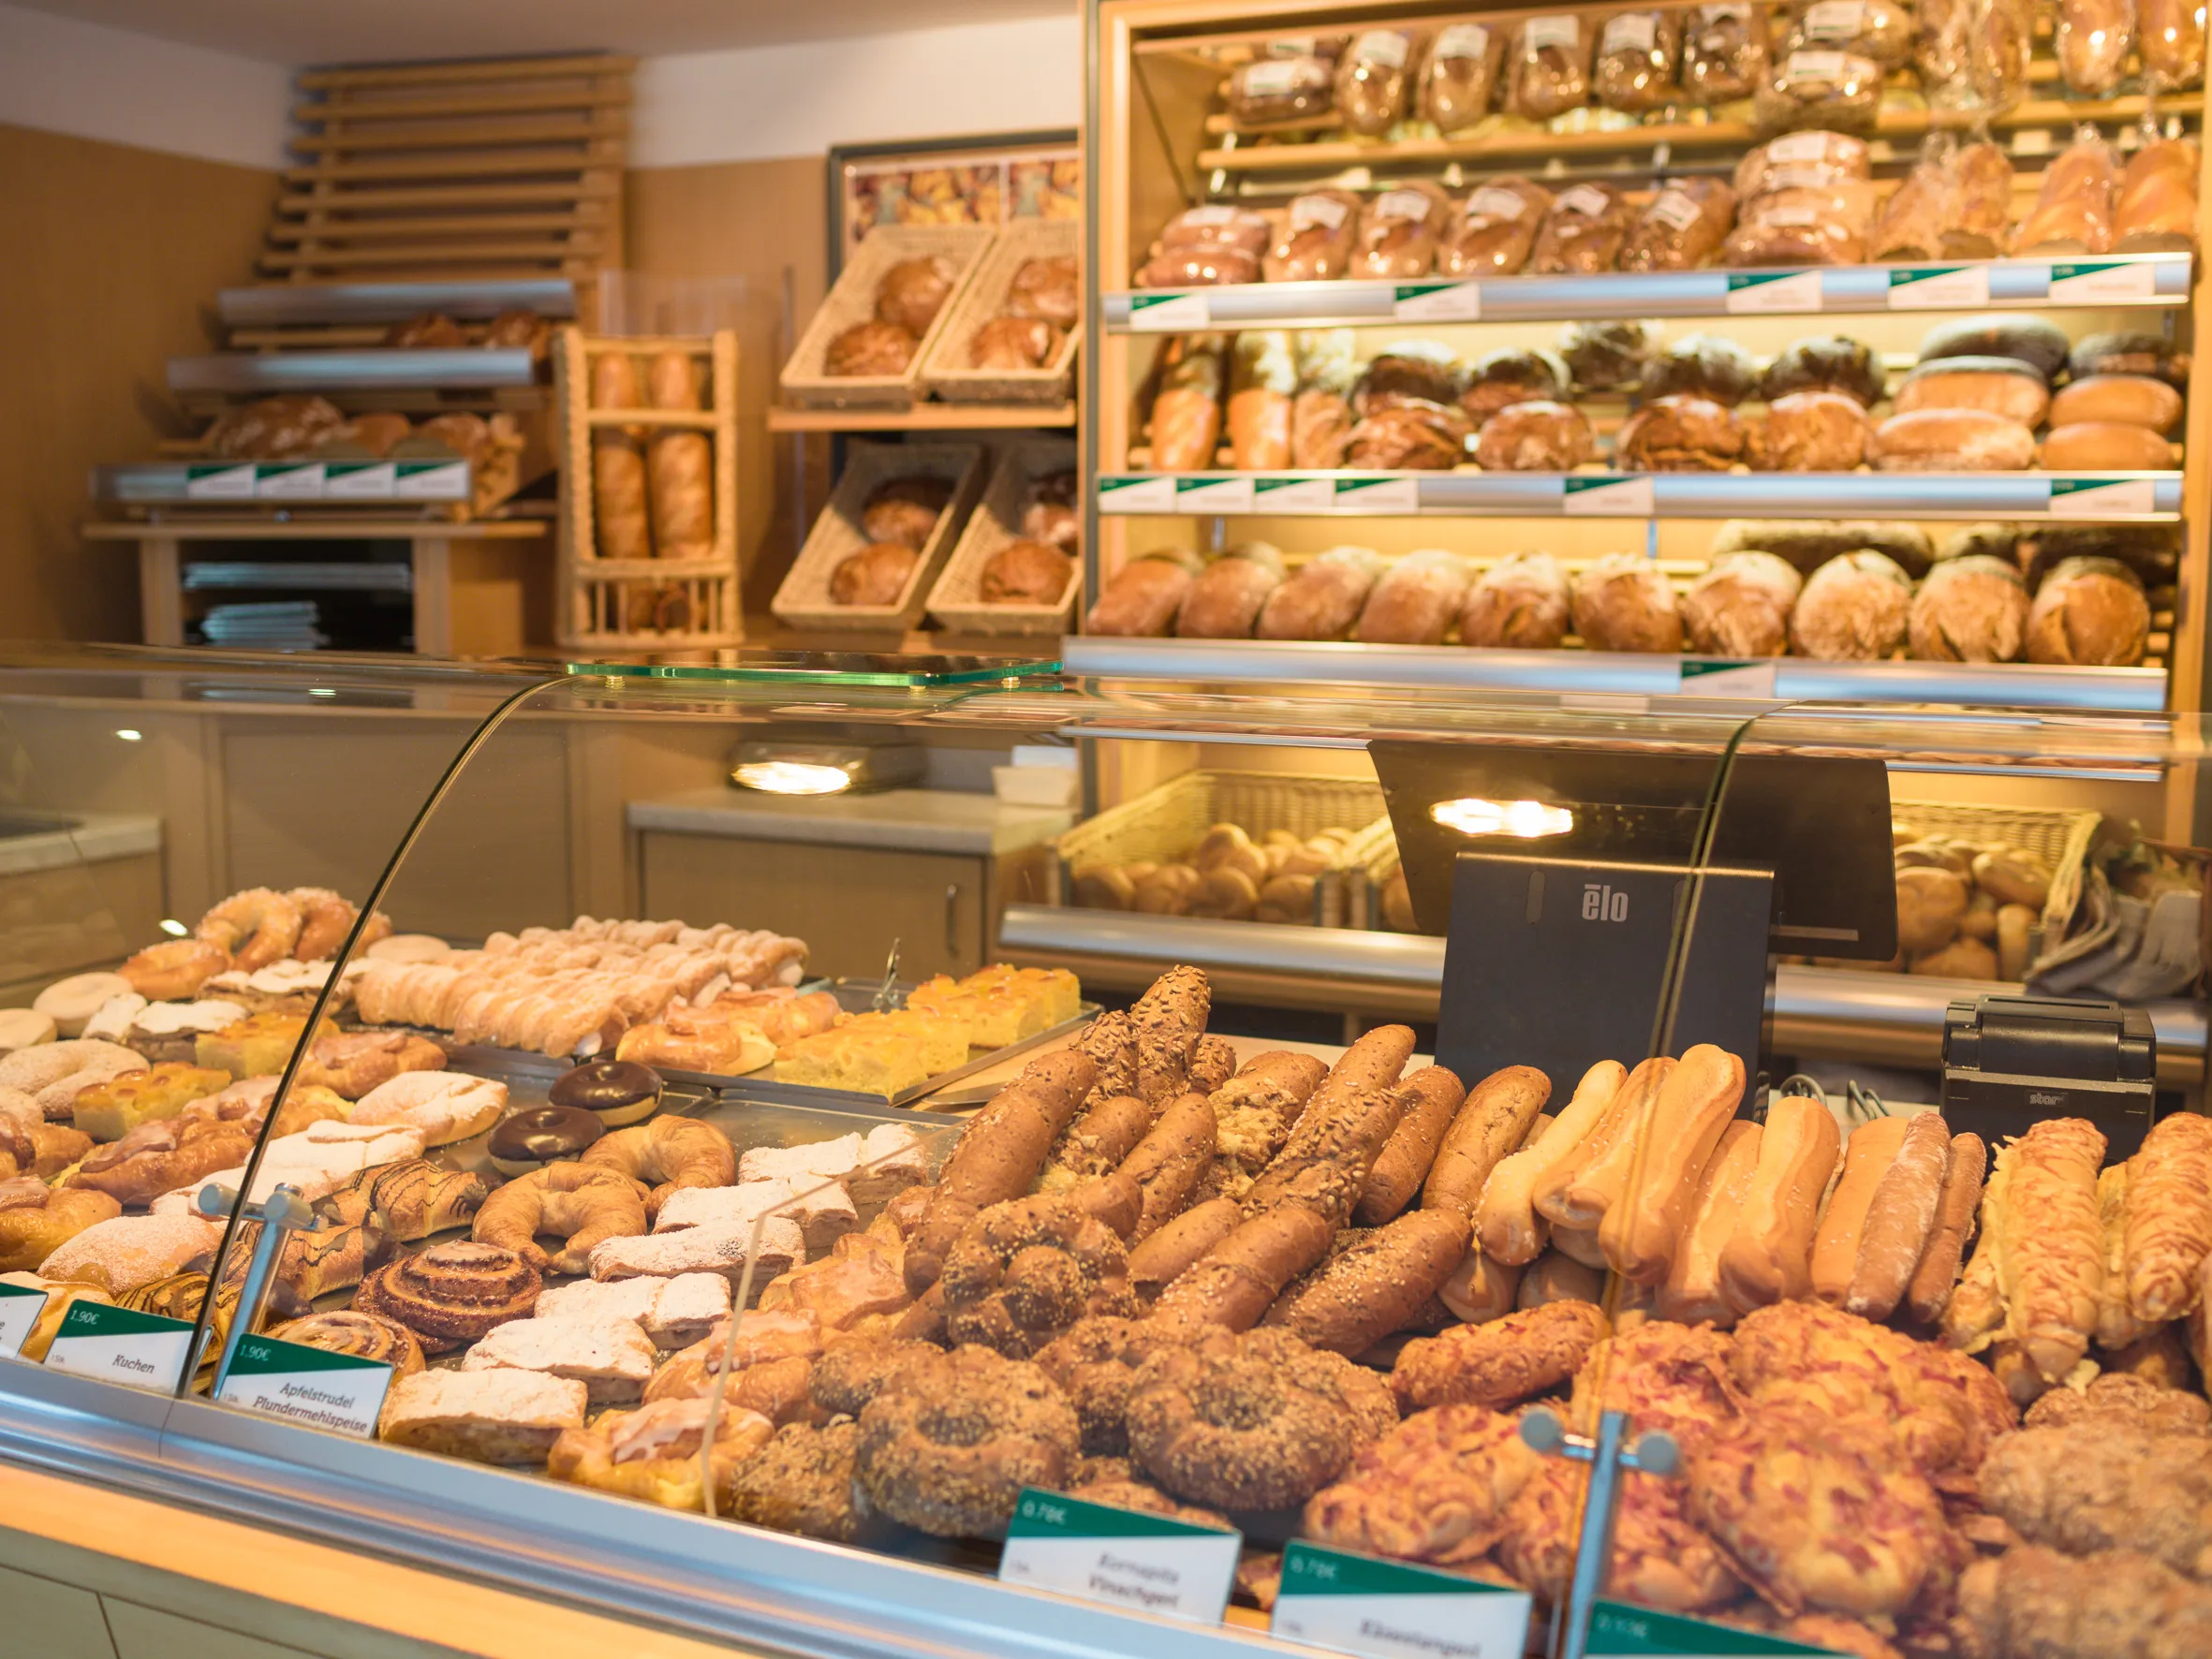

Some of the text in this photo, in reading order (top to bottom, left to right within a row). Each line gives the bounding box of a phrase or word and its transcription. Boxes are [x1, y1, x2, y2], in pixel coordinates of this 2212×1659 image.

[2029, 1093, 2059, 1105] star
[112, 1355, 155, 1373] Kuchen
[279, 1383, 356, 1409] Apfelstrudel
[253, 1396, 368, 1432] Plundermehlspeise
